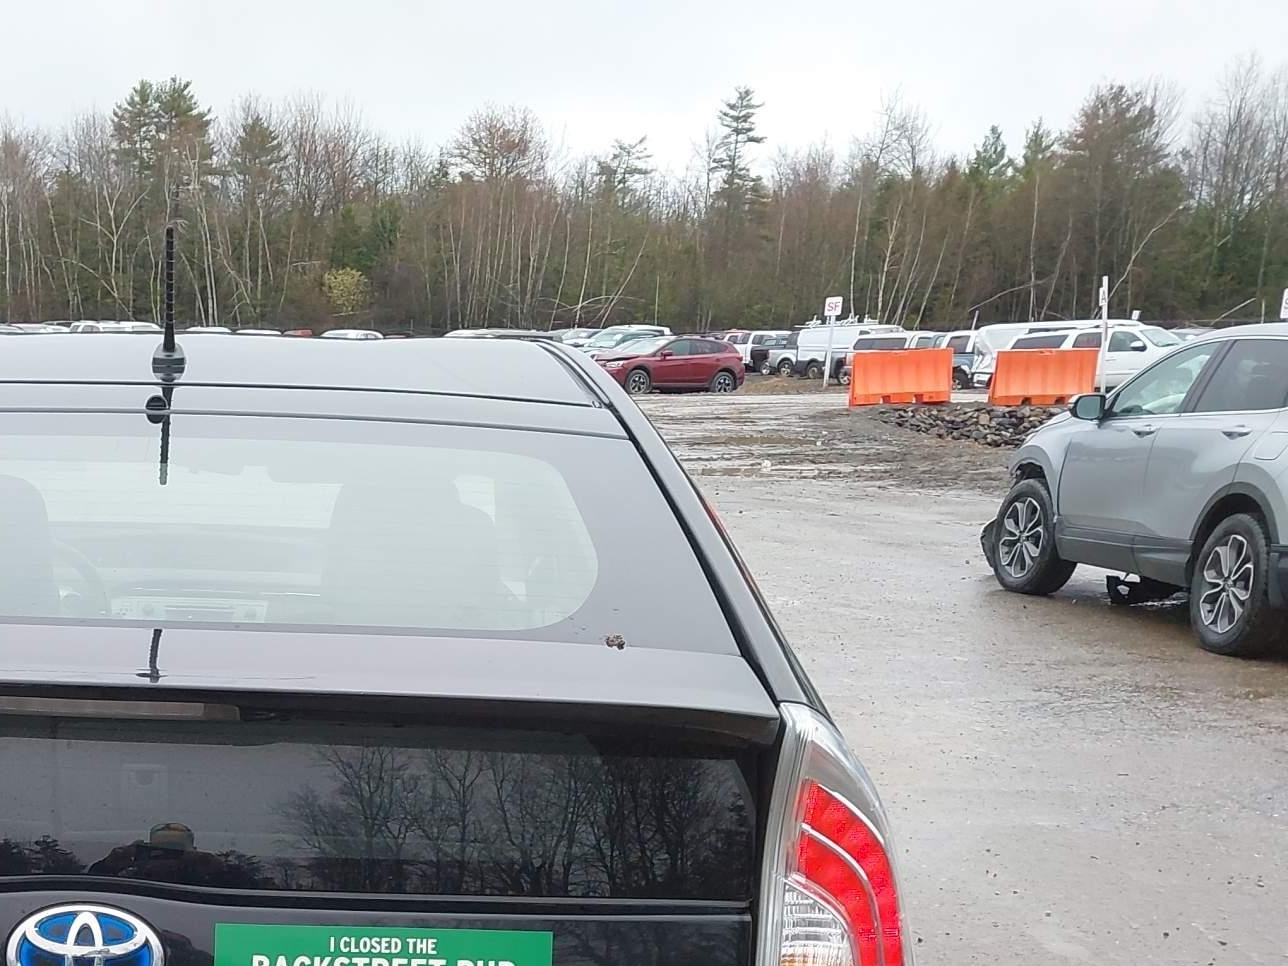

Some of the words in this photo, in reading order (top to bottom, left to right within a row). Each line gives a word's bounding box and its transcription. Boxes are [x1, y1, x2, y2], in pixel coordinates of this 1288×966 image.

[827, 301, 841, 312] SF
[330, 936, 336, 953] I
[339, 937, 402, 955] CLOSED
[406, 939, 438, 955] THE
